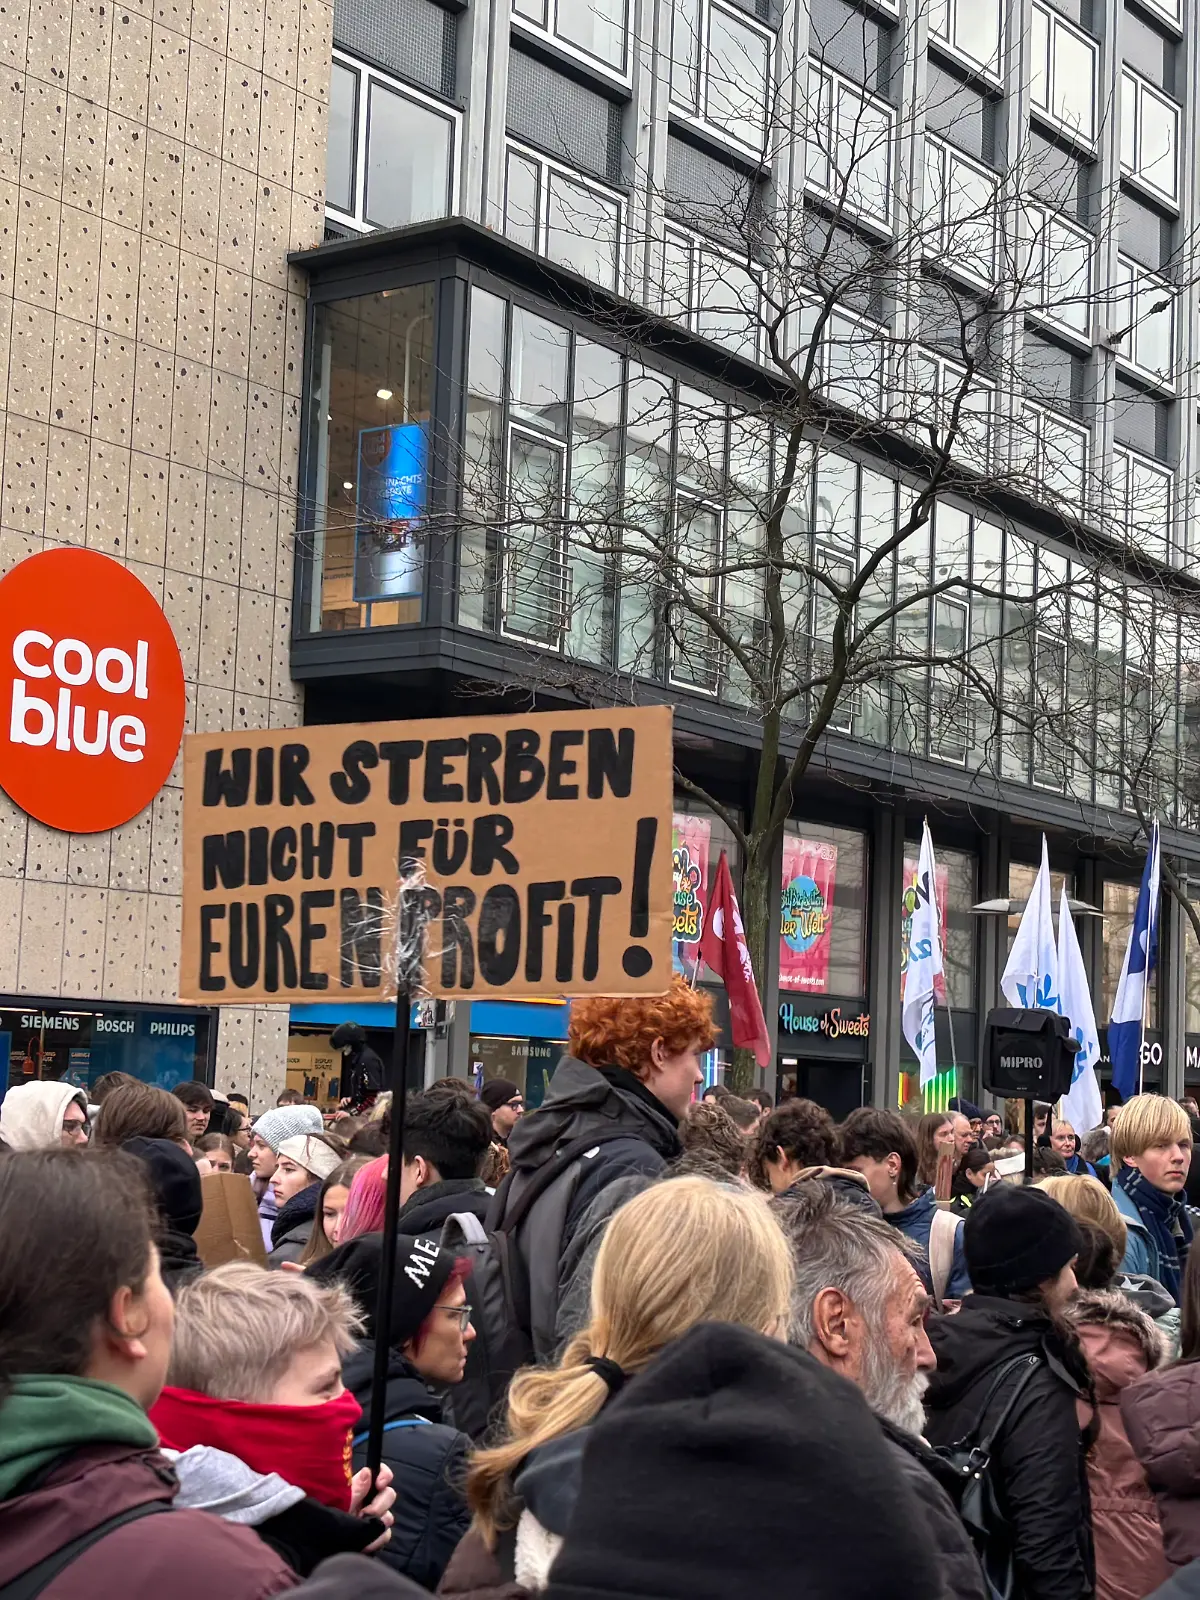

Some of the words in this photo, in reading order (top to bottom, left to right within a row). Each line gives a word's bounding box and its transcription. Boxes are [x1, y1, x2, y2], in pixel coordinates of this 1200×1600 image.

[12, 629, 149, 700] cool
[9, 678, 146, 763] blue
[202, 743, 316, 807] WIR
[329, 727, 635, 805] STERBEN
[202, 821, 376, 890] NICHT
[398, 813, 520, 883] FÜR
[199, 886, 383, 992] EUREN
[801, 912, 830, 939] Welt
[20, 1014, 80, 1031] SIEMENS
[96, 1019, 135, 1033] BOSCH
[150, 1022, 196, 1036] PHILIPS
[779, 1002, 819, 1035] House
[829, 1007, 871, 1038] Sweets
[511, 1046, 552, 1058] SAMSUNG
[1000, 1056, 1043, 1068] MIPRO
[1140, 1041, 1163, 1066] GO
